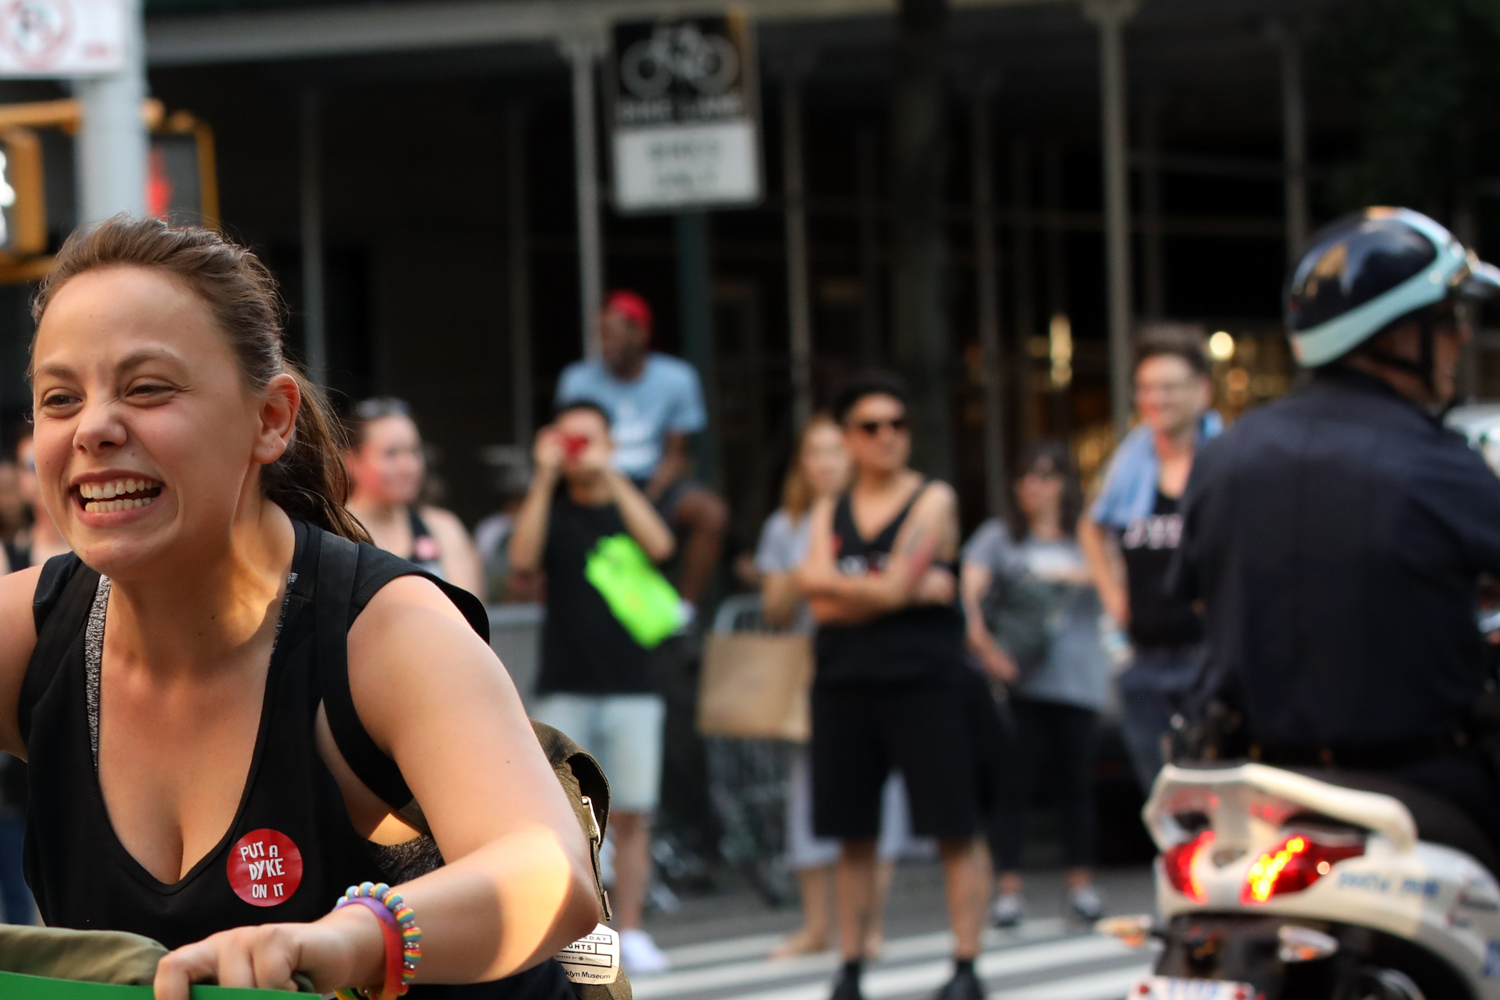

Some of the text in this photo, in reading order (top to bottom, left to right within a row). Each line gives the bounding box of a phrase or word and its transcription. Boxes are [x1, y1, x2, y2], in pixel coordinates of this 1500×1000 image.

[240, 841, 278, 862] PUT A
[248, 858, 285, 881] DYKE
[252, 883, 284, 898] ON IT
[565, 943, 592, 951] GHTS
[581, 971, 611, 980] Museum
